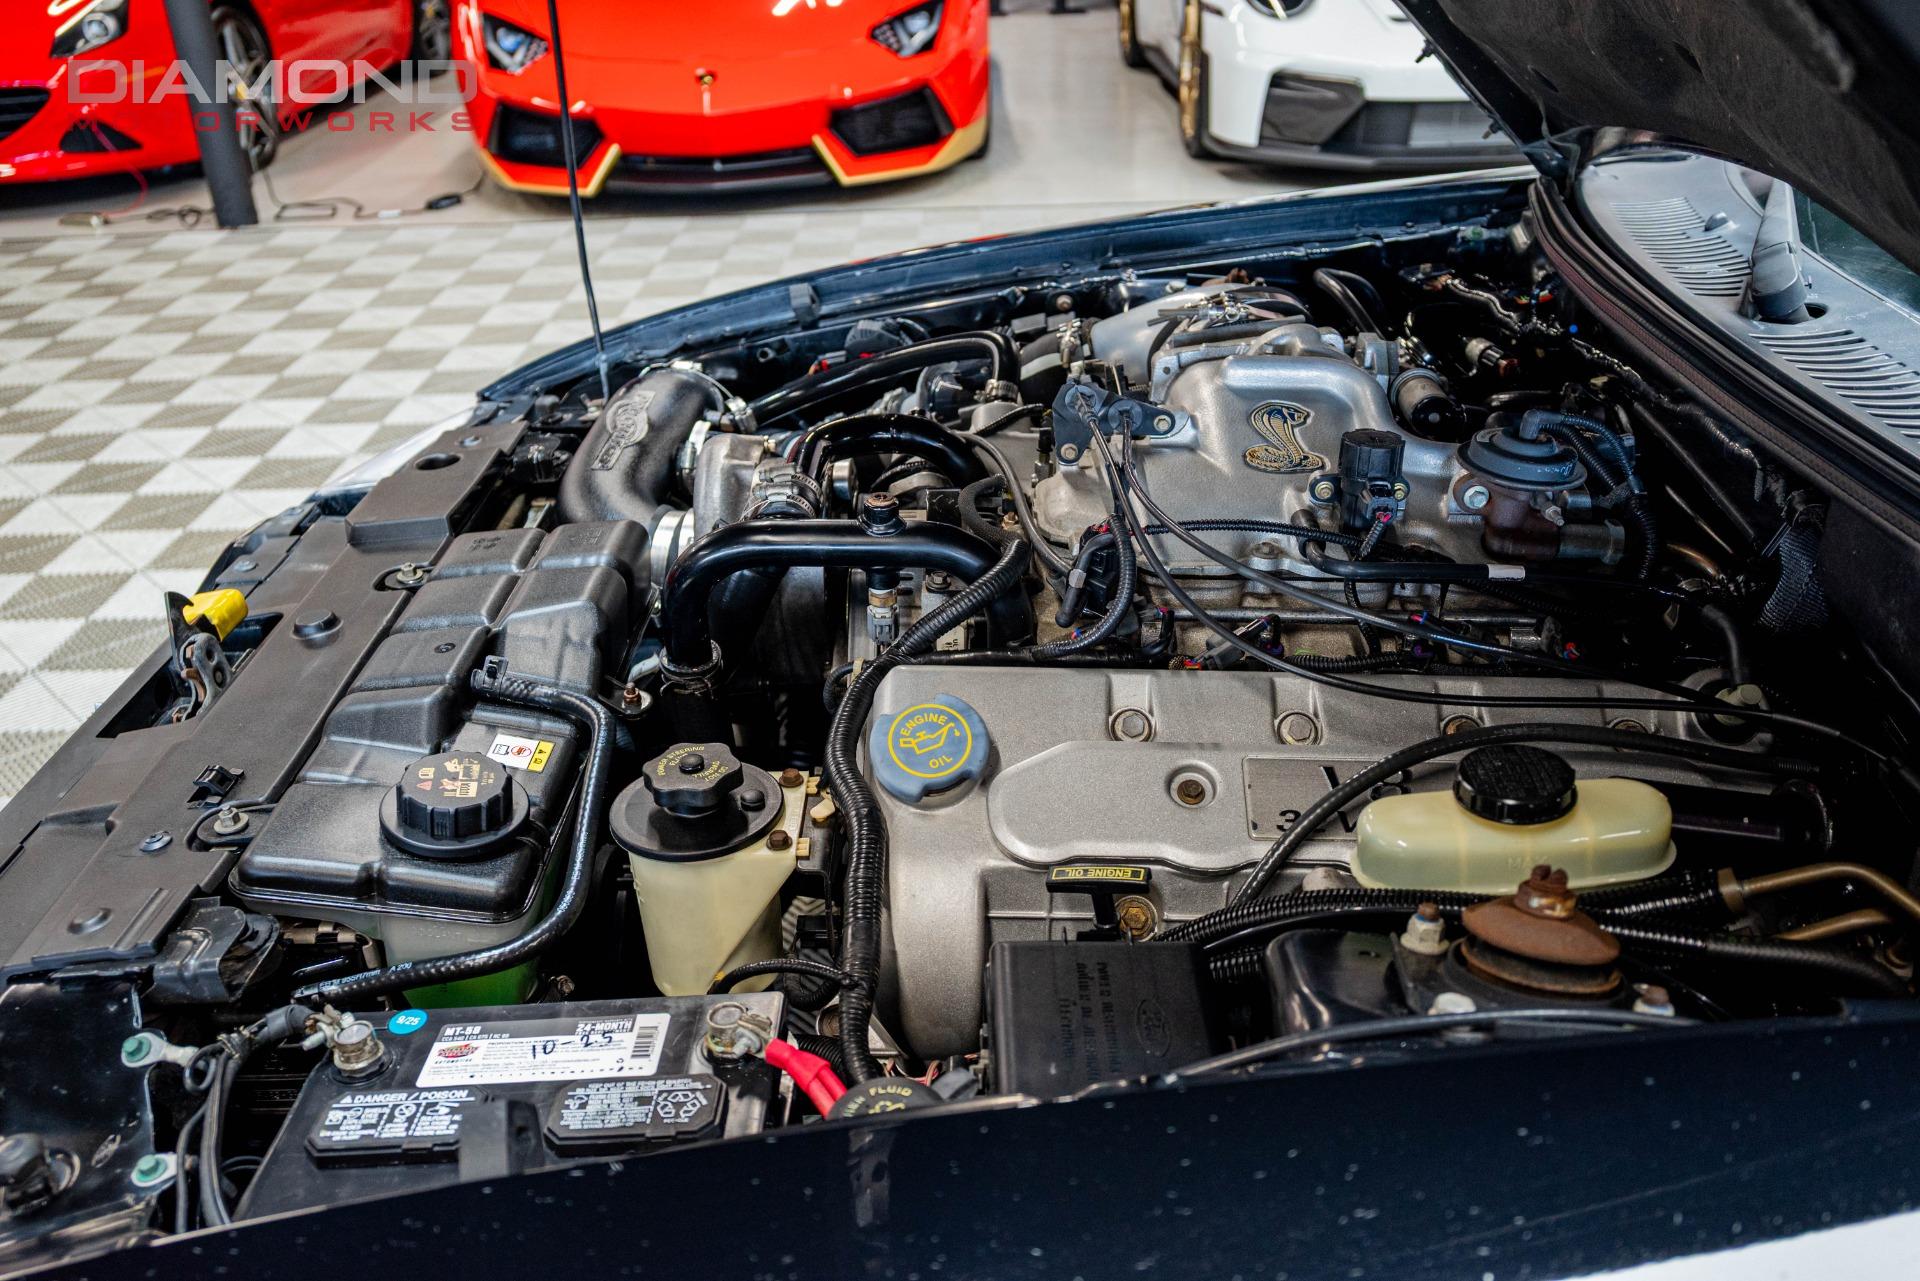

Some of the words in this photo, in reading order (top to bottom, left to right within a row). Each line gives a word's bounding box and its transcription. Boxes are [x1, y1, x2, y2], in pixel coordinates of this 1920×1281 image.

[900, 713, 948, 736] ENGINE
[929, 755, 953, 769] OIL
[1065, 869, 1084, 877] OIL
[1087, 869, 1132, 878] ENGINE
[395, 1015, 421, 1026] 9/25
[576, 1020, 633, 1032] 24-MONTH
[353, 1092, 408, 1104] DANGER
[419, 1089, 469, 1100] POISON
[868, 1085, 913, 1097] FLUID
